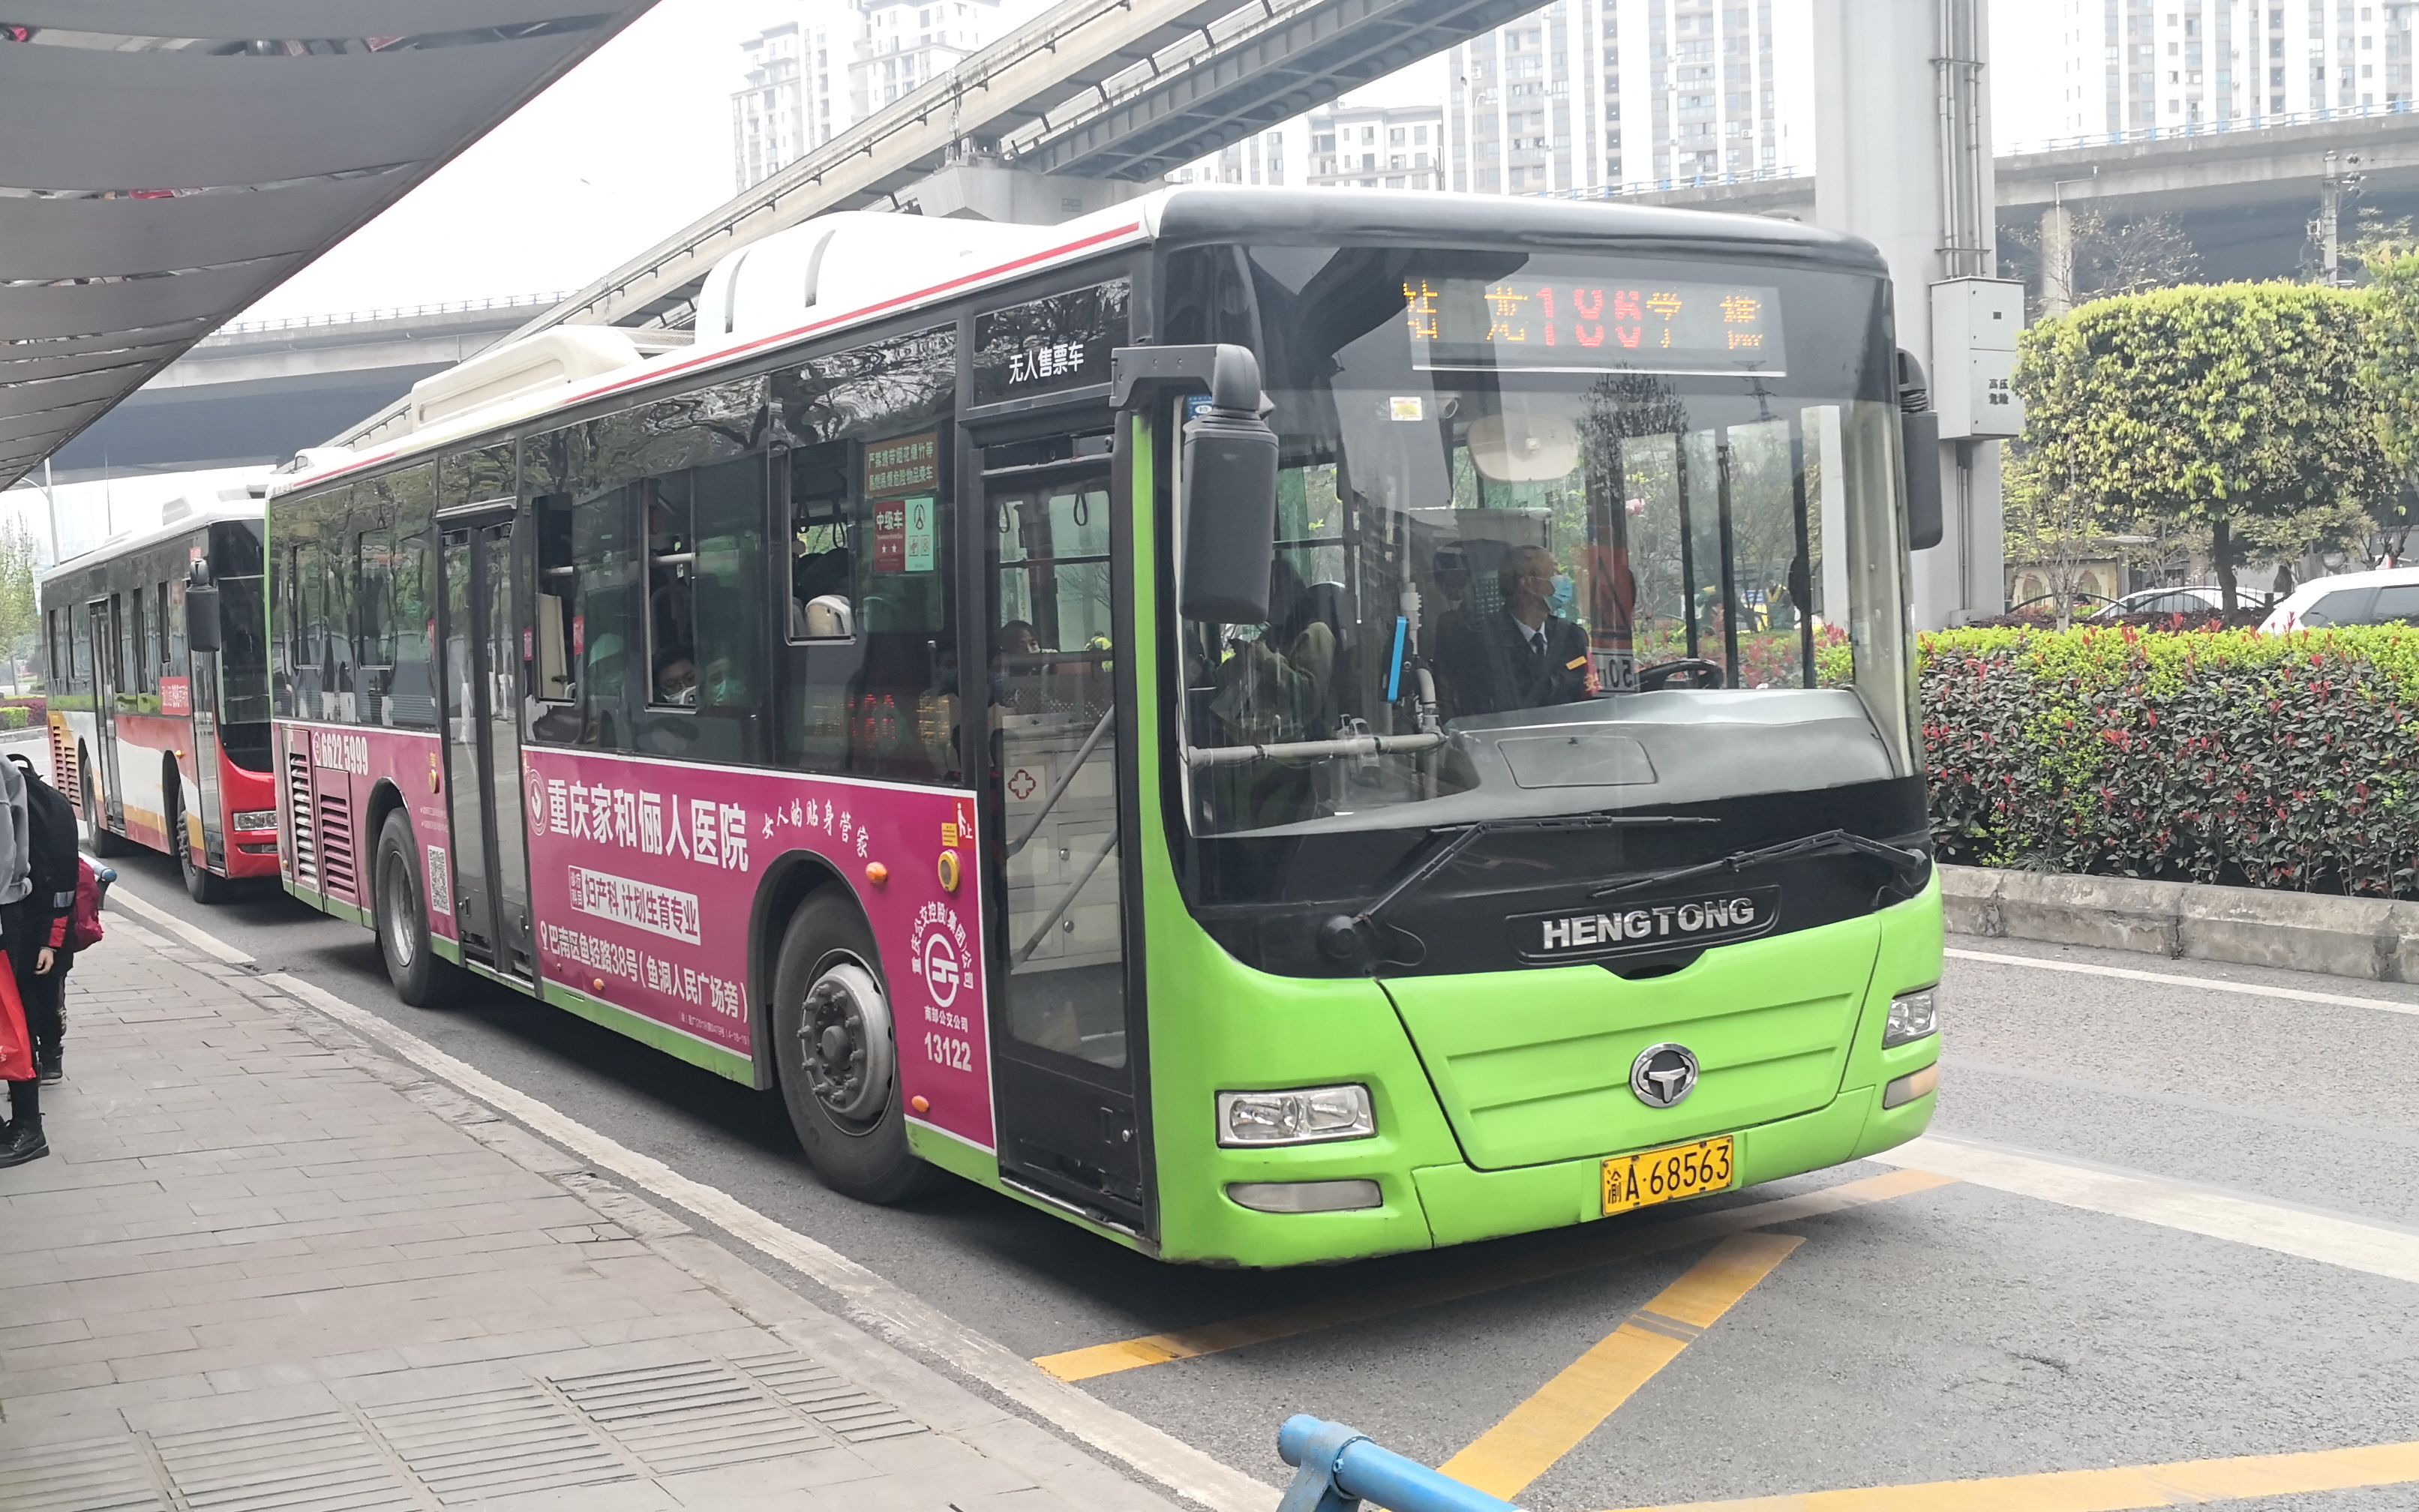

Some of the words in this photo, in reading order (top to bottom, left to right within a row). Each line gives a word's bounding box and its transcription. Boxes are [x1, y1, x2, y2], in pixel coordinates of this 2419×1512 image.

[1009, 340, 1084, 384] 无人售票车
[876, 510, 904, 531] 中级车
[548, 779, 749, 872] 重庆家和俪人医院
[762, 798, 869, 858] 女人的贴身管家
[585, 874, 619, 916] 妇产科
[622, 884, 698, 937] 计划生育专业
[1542, 898, 1754, 950] HENGTONG
[924, 1006, 968, 1033] 南部公交公司
[924, 1031, 972, 1072] 13122
